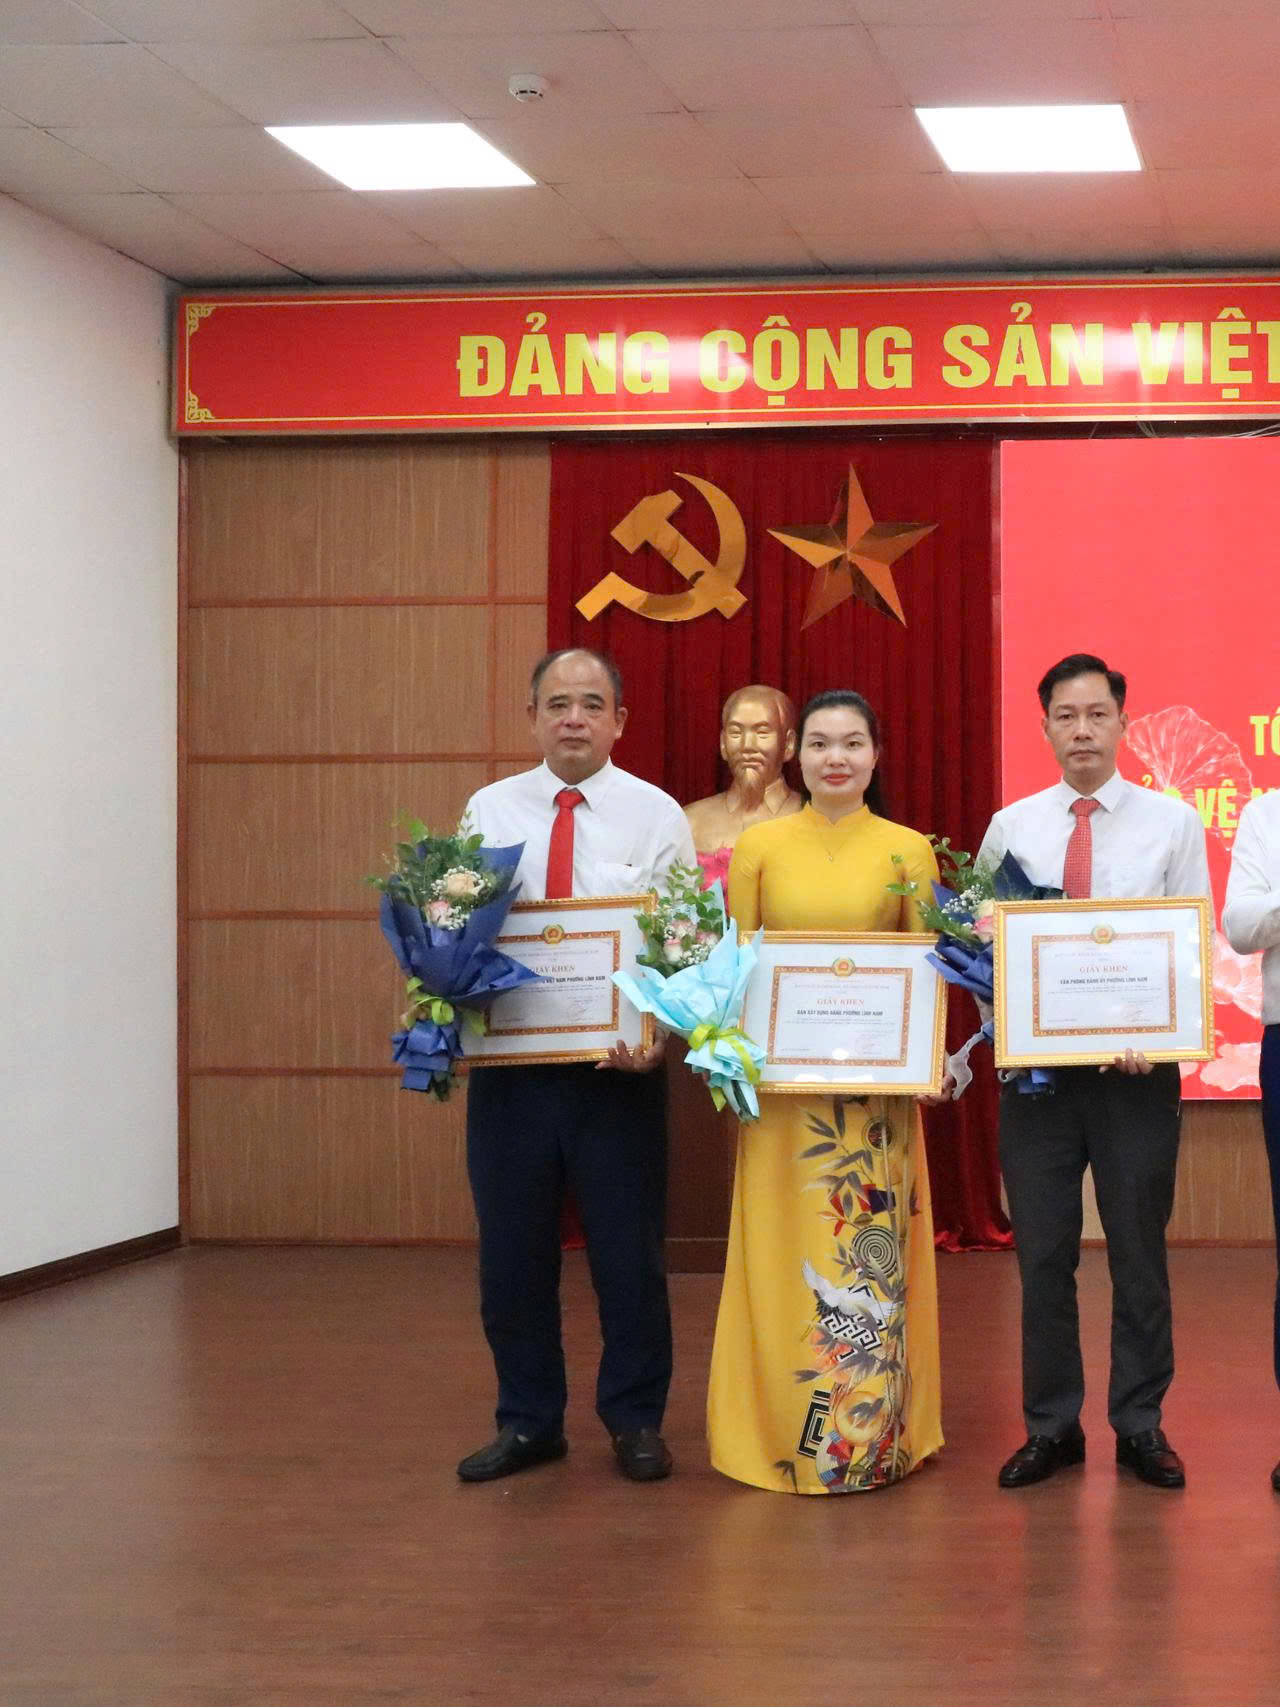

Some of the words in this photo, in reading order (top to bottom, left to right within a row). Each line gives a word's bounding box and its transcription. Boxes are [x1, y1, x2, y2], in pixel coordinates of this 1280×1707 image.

[456, 311, 671, 397] ĐẢNG
[698, 315, 913, 405] CỘNG
[942, 302, 1105, 388] SẢN
[1194, 779, 1240, 837] VỆ
